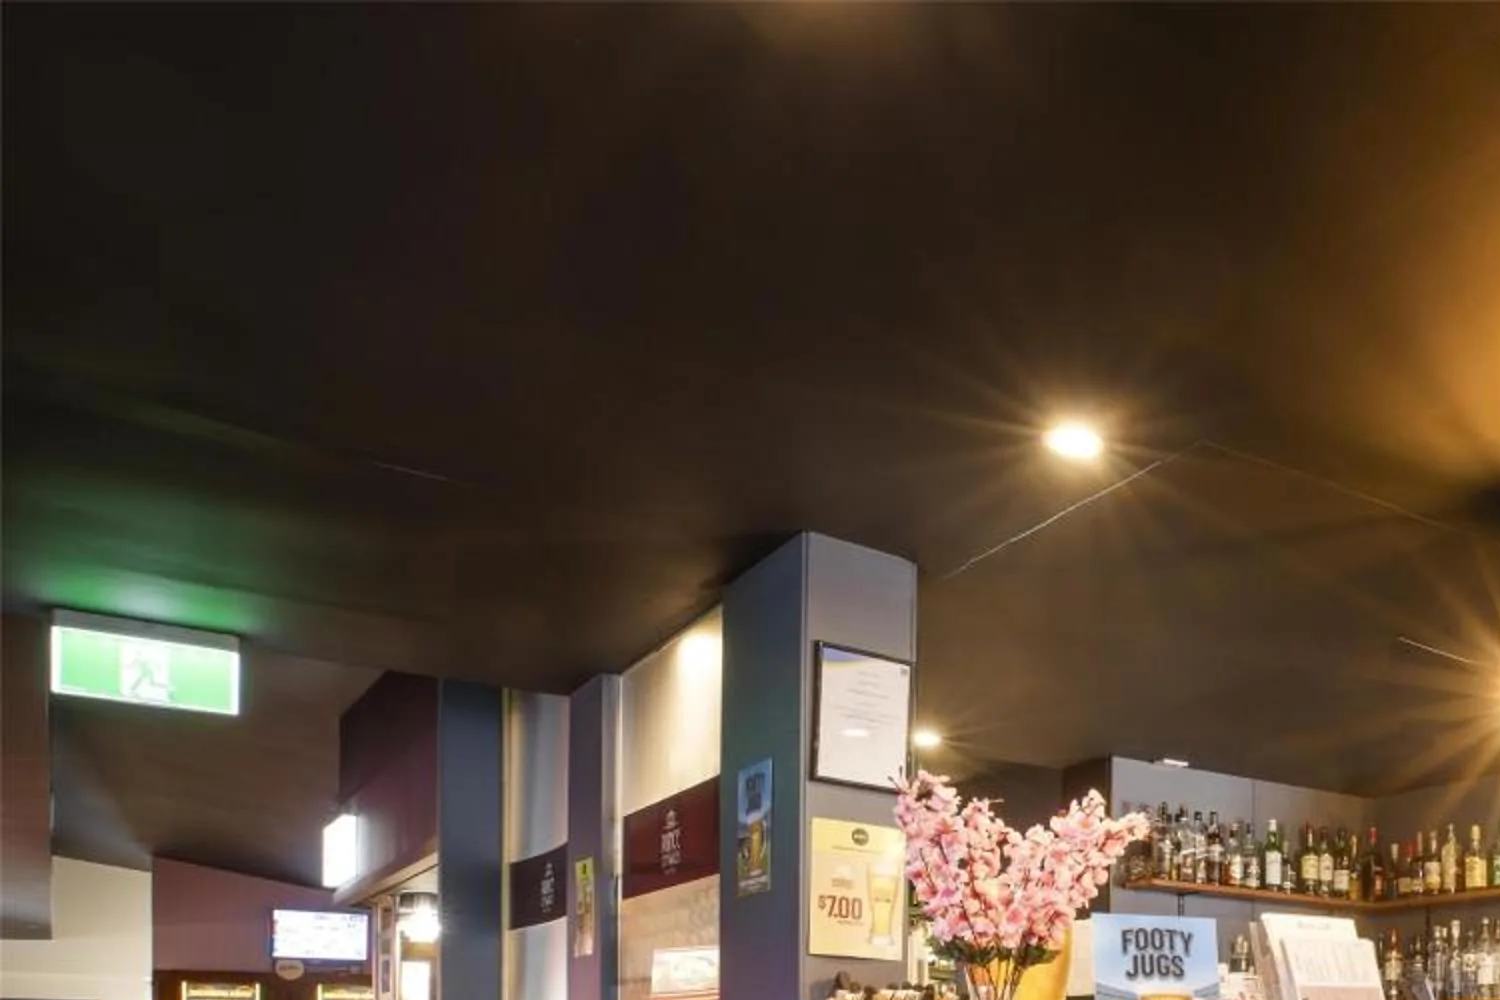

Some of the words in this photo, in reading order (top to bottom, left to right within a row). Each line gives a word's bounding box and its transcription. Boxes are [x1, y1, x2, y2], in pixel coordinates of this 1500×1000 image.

[817, 894, 863, 920] $7.00
[1121, 927, 1194, 955] FOOTY
[1125, 955, 1185, 979] JUGS
